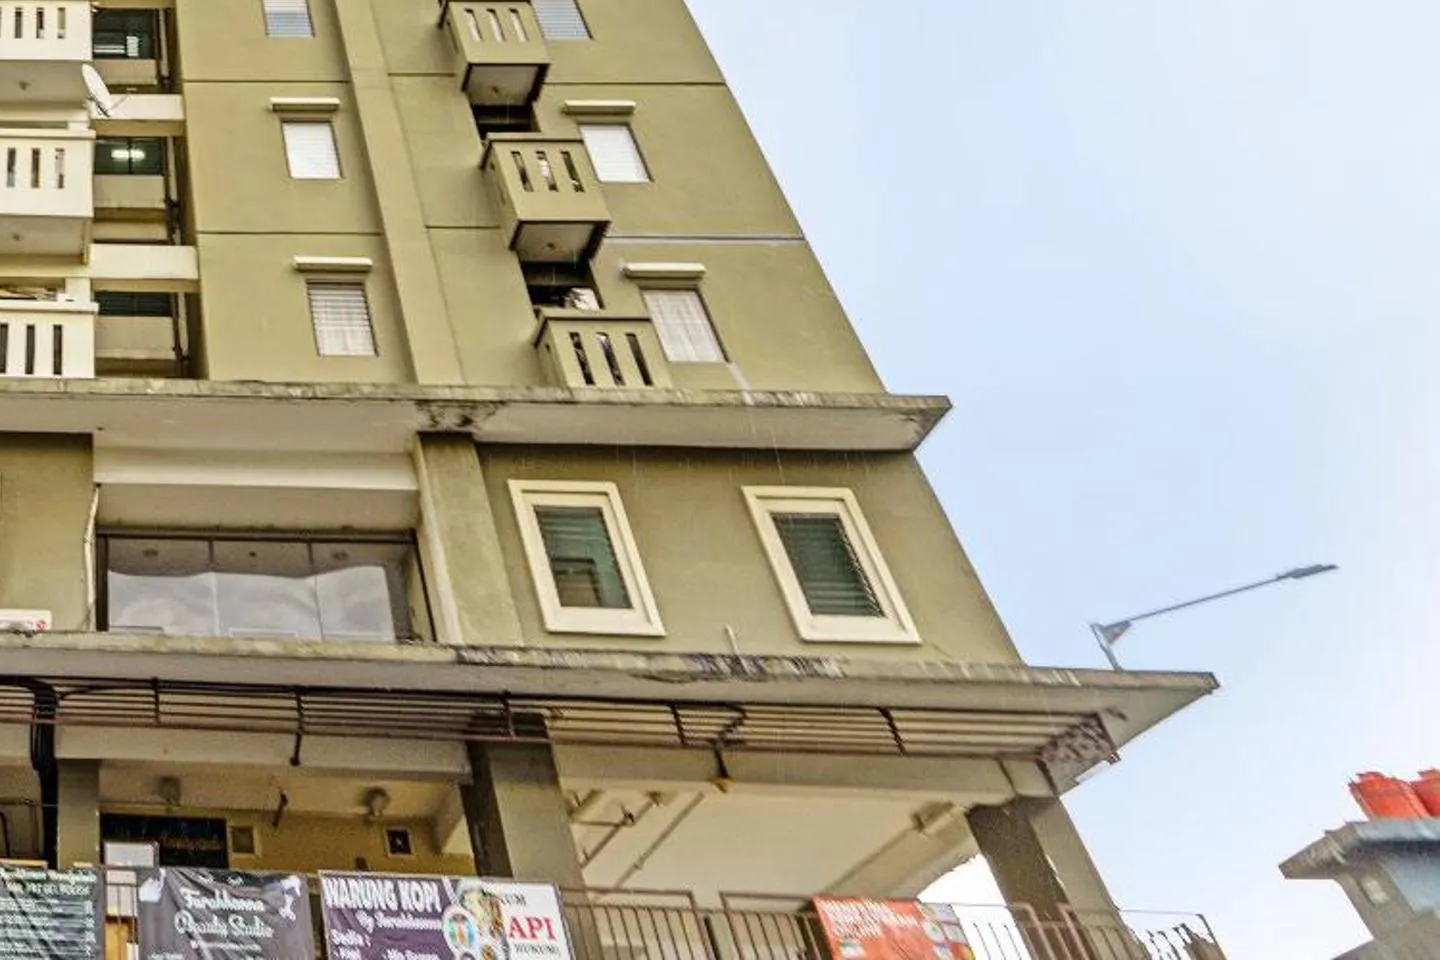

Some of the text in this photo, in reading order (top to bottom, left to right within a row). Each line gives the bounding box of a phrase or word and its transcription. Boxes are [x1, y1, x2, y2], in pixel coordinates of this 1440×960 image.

[321, 877, 442, 913] WARUNG KOPI
[509, 915, 557, 941] API
